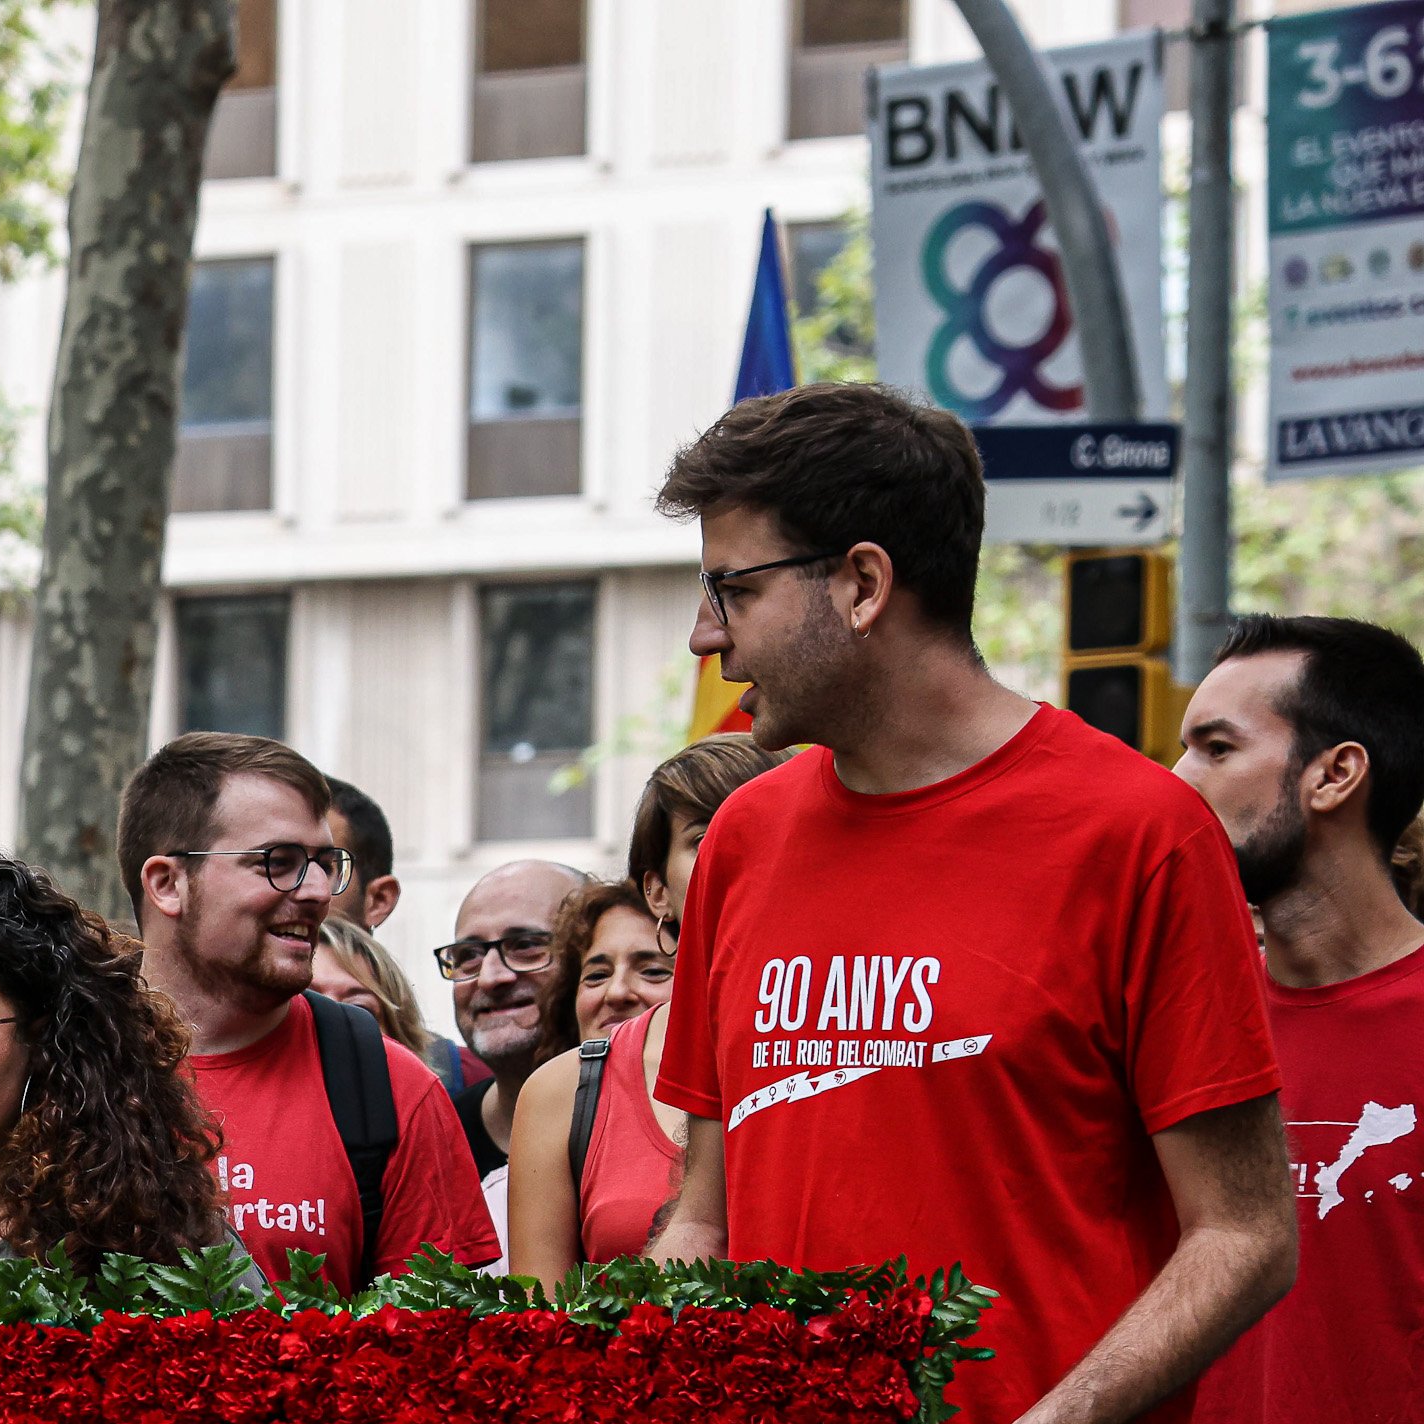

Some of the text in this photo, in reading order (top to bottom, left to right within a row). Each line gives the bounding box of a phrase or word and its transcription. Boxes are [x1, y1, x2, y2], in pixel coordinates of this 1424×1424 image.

[887, 64, 1143, 168] BNW
[754, 955, 941, 1033] 90 ANYS
[753, 1040, 928, 1068] DE FIL ROIG DEL COMBAT
[218, 1156, 254, 1191] la
[223, 1199, 325, 1236] rtat!
